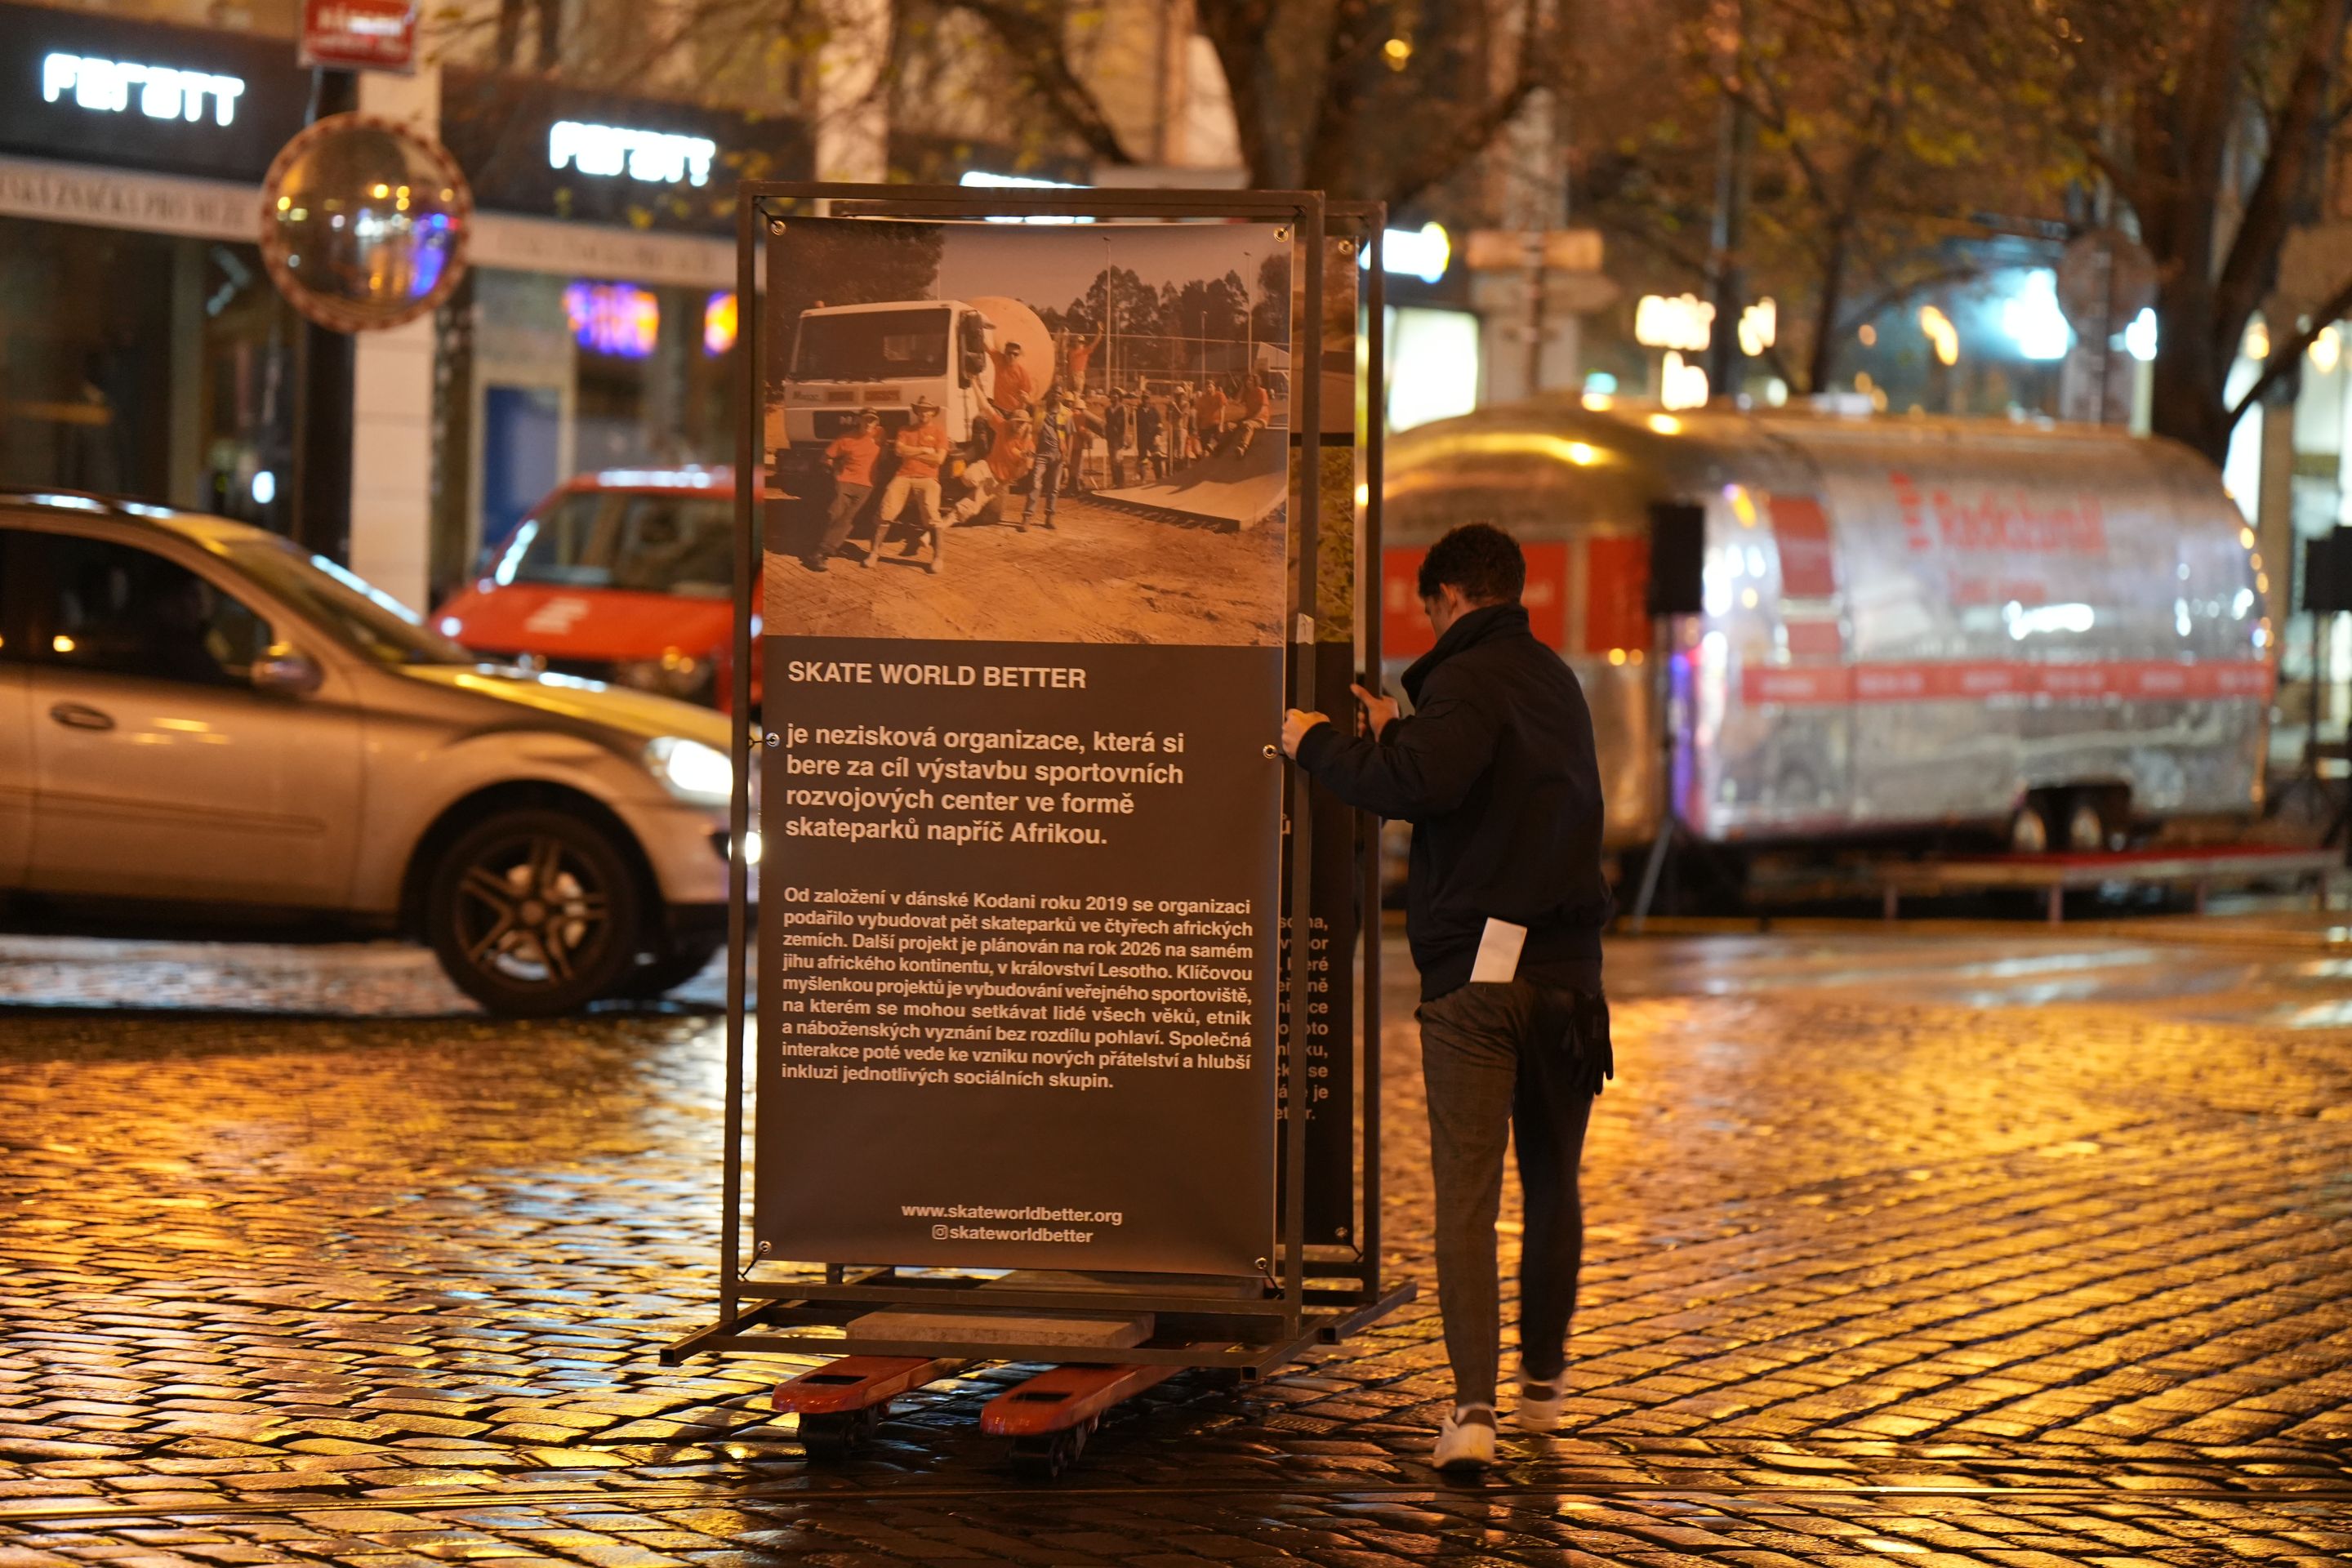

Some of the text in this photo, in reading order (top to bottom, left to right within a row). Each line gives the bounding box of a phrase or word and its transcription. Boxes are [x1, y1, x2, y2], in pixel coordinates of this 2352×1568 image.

[787, 660, 1087, 689] SKATE WORLD BETTER
[786, 722, 1184, 755] je nezisková organizace, která si
[786, 754, 1184, 786] bere za cíl výstavbu sportovních
[786, 786, 1135, 814] rozvojových center ve formě
[785, 816, 1108, 847] skateparků napříč Afrikou.
[783, 886, 1251, 917] Od založení v dánské Kodani roku 2019 se organizaci
[783, 909, 1254, 940] podařilo vybudovat pět skateparků ve čtyřech afrických
[782, 931, 1254, 959] zemích. Další projekt je plánován na rok 2026 na samém
[782, 952, 1253, 981] jihu afrického kontinentu, v království Lesotho. Klíčovou
[782, 975, 1253, 1006] myšlenkou projektů je vybudování veřejného sportoviště,
[782, 998, 1252, 1027] na kterém se mohou setkávat lidé všech věků, etnik
[781, 1019, 1252, 1050] a náboženských vyznání bez rozdílu pohlaví. Společná
[782, 1040, 1252, 1070] interakce poté vede ke vzniku nových přátelství a hlubší
[781, 1062, 1114, 1092] inkluzi jednotlivých sociálních skupin.
[1307, 1066, 1329, 1078] se
[1312, 1085, 1330, 1102] je
[901, 1204, 1123, 1226] www.skateworldbetter.org
[949, 1225, 1094, 1243] skateworldbetter
